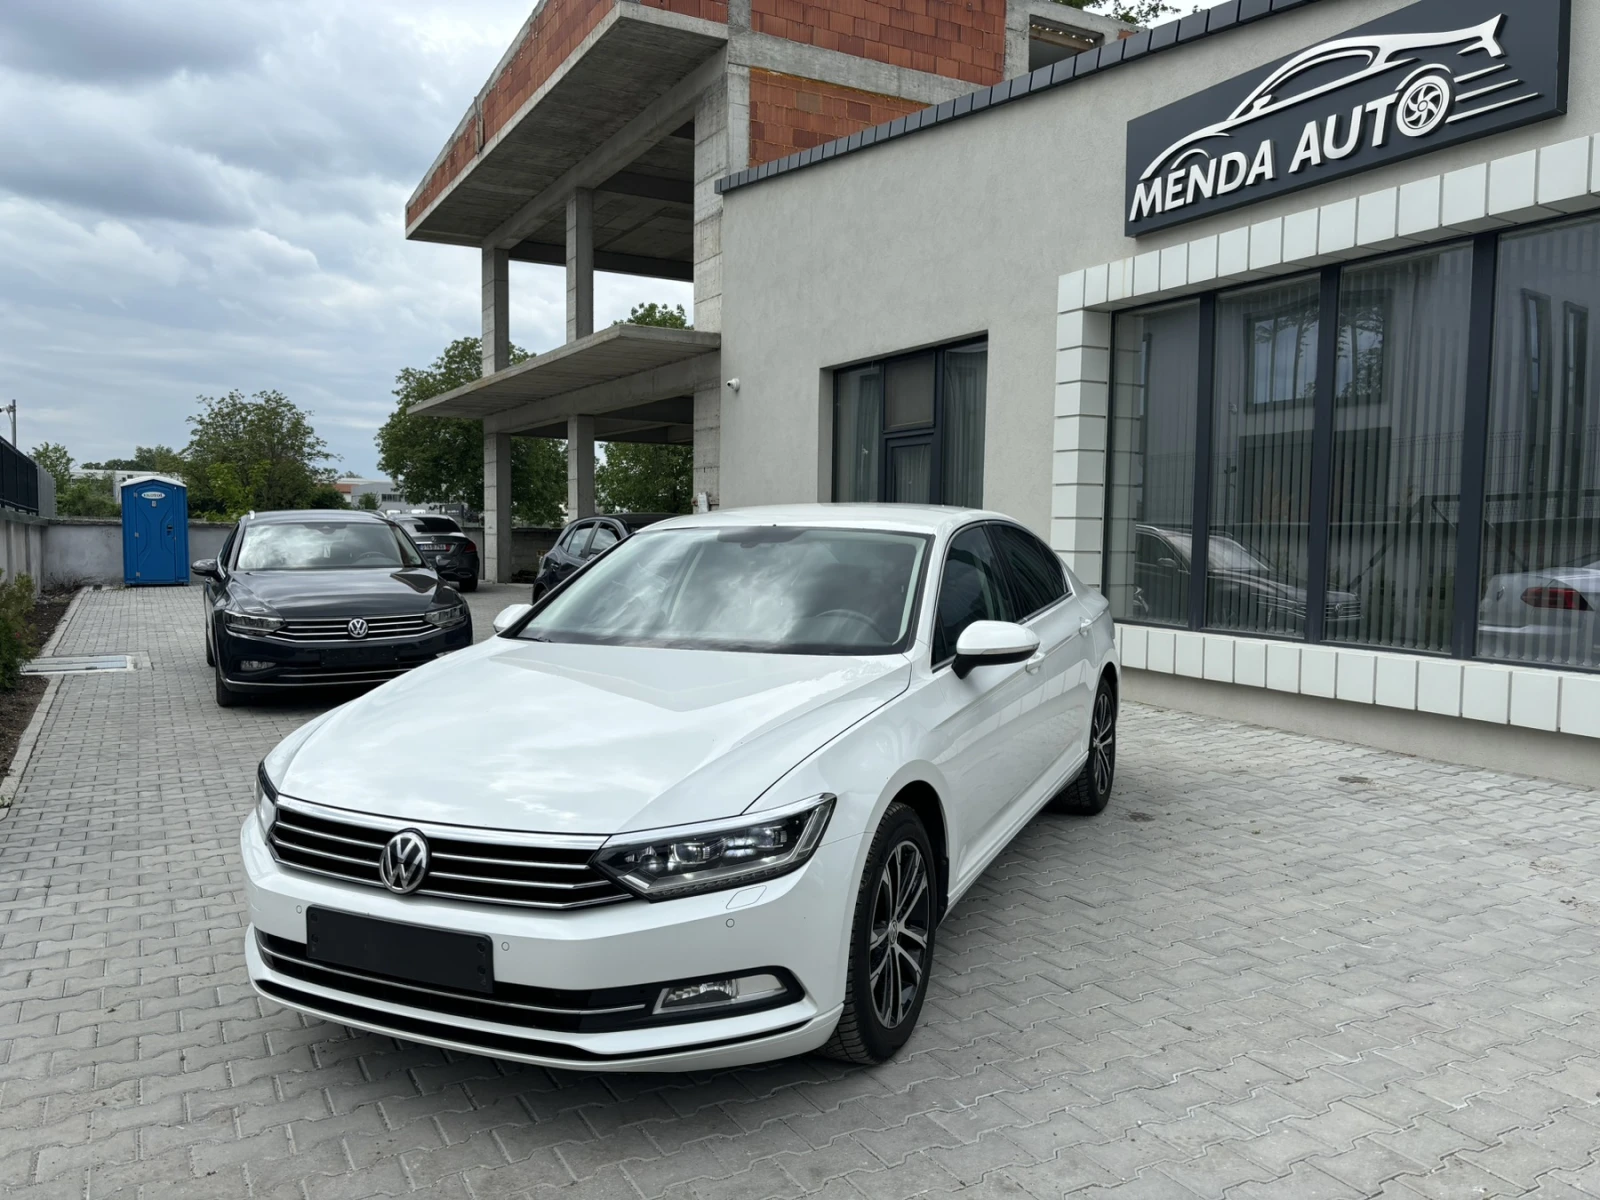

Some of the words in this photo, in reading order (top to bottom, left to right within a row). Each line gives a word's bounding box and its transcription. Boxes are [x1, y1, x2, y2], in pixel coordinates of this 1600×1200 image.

[1129, 139, 1275, 222] MENDA
[1288, 75, 1450, 174] AUTO
[382, 833, 427, 892] VW
